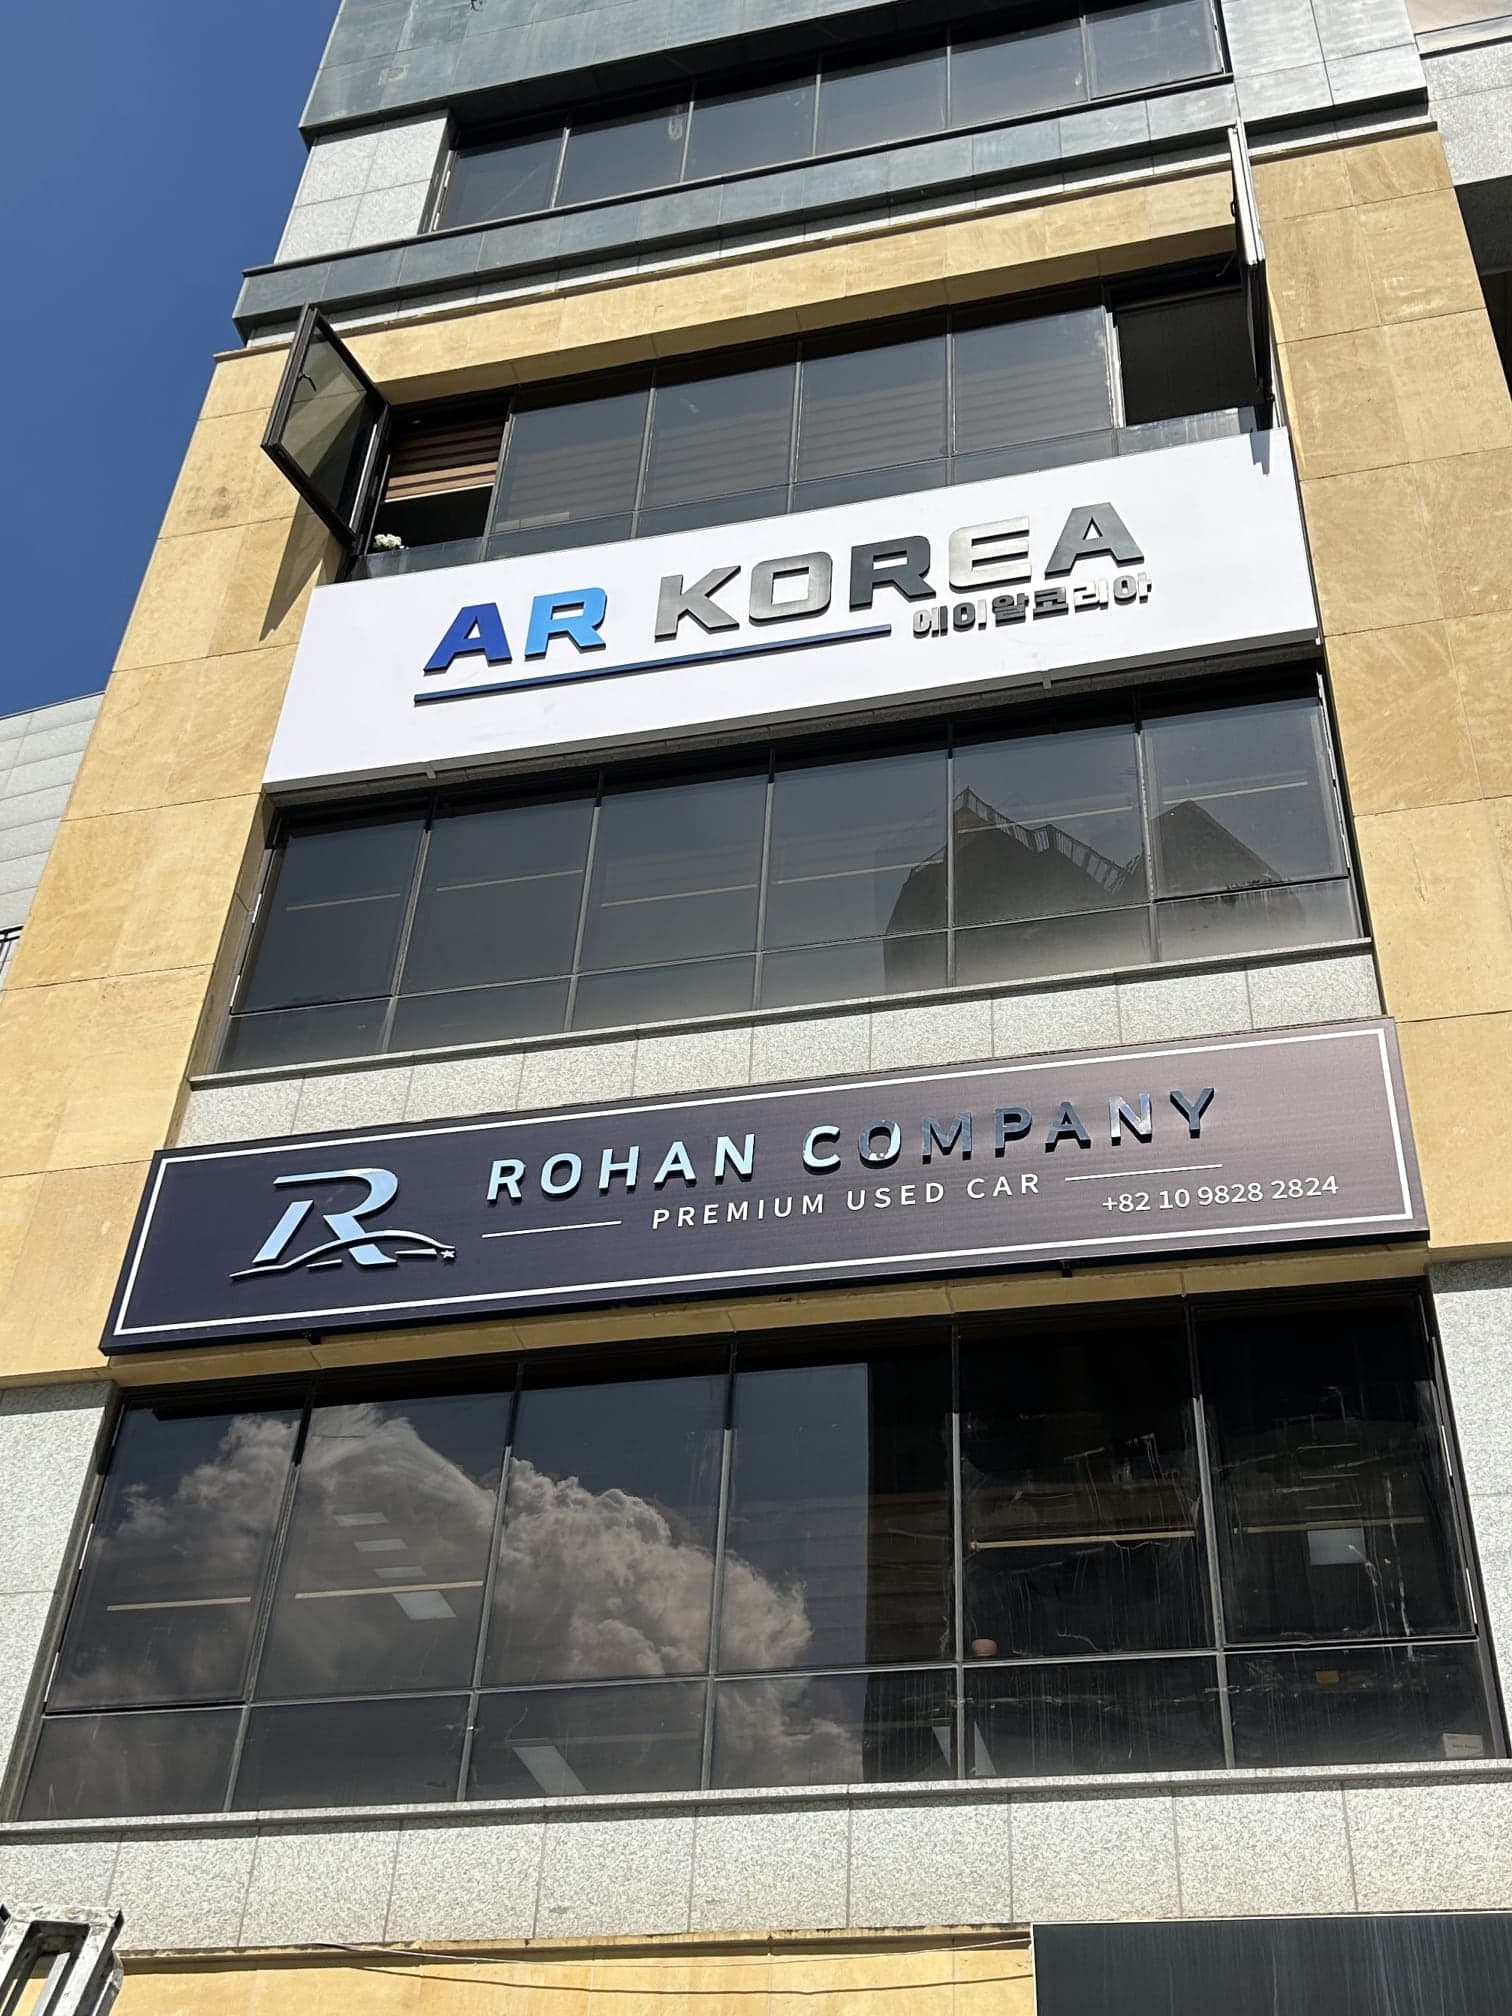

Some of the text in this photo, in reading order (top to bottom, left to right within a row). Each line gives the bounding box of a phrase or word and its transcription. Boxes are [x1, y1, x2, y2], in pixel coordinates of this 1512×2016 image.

[423, 501, 1145, 675] AR KOREA
[912, 572, 1152, 639] 에이알코리아
[485, 1087, 1216, 1204] ROHAN COMPANY
[651, 1173, 1040, 1230] PREMIUM USED CAR
[1102, 1175, 1339, 1212] +82 10 9828 2824
